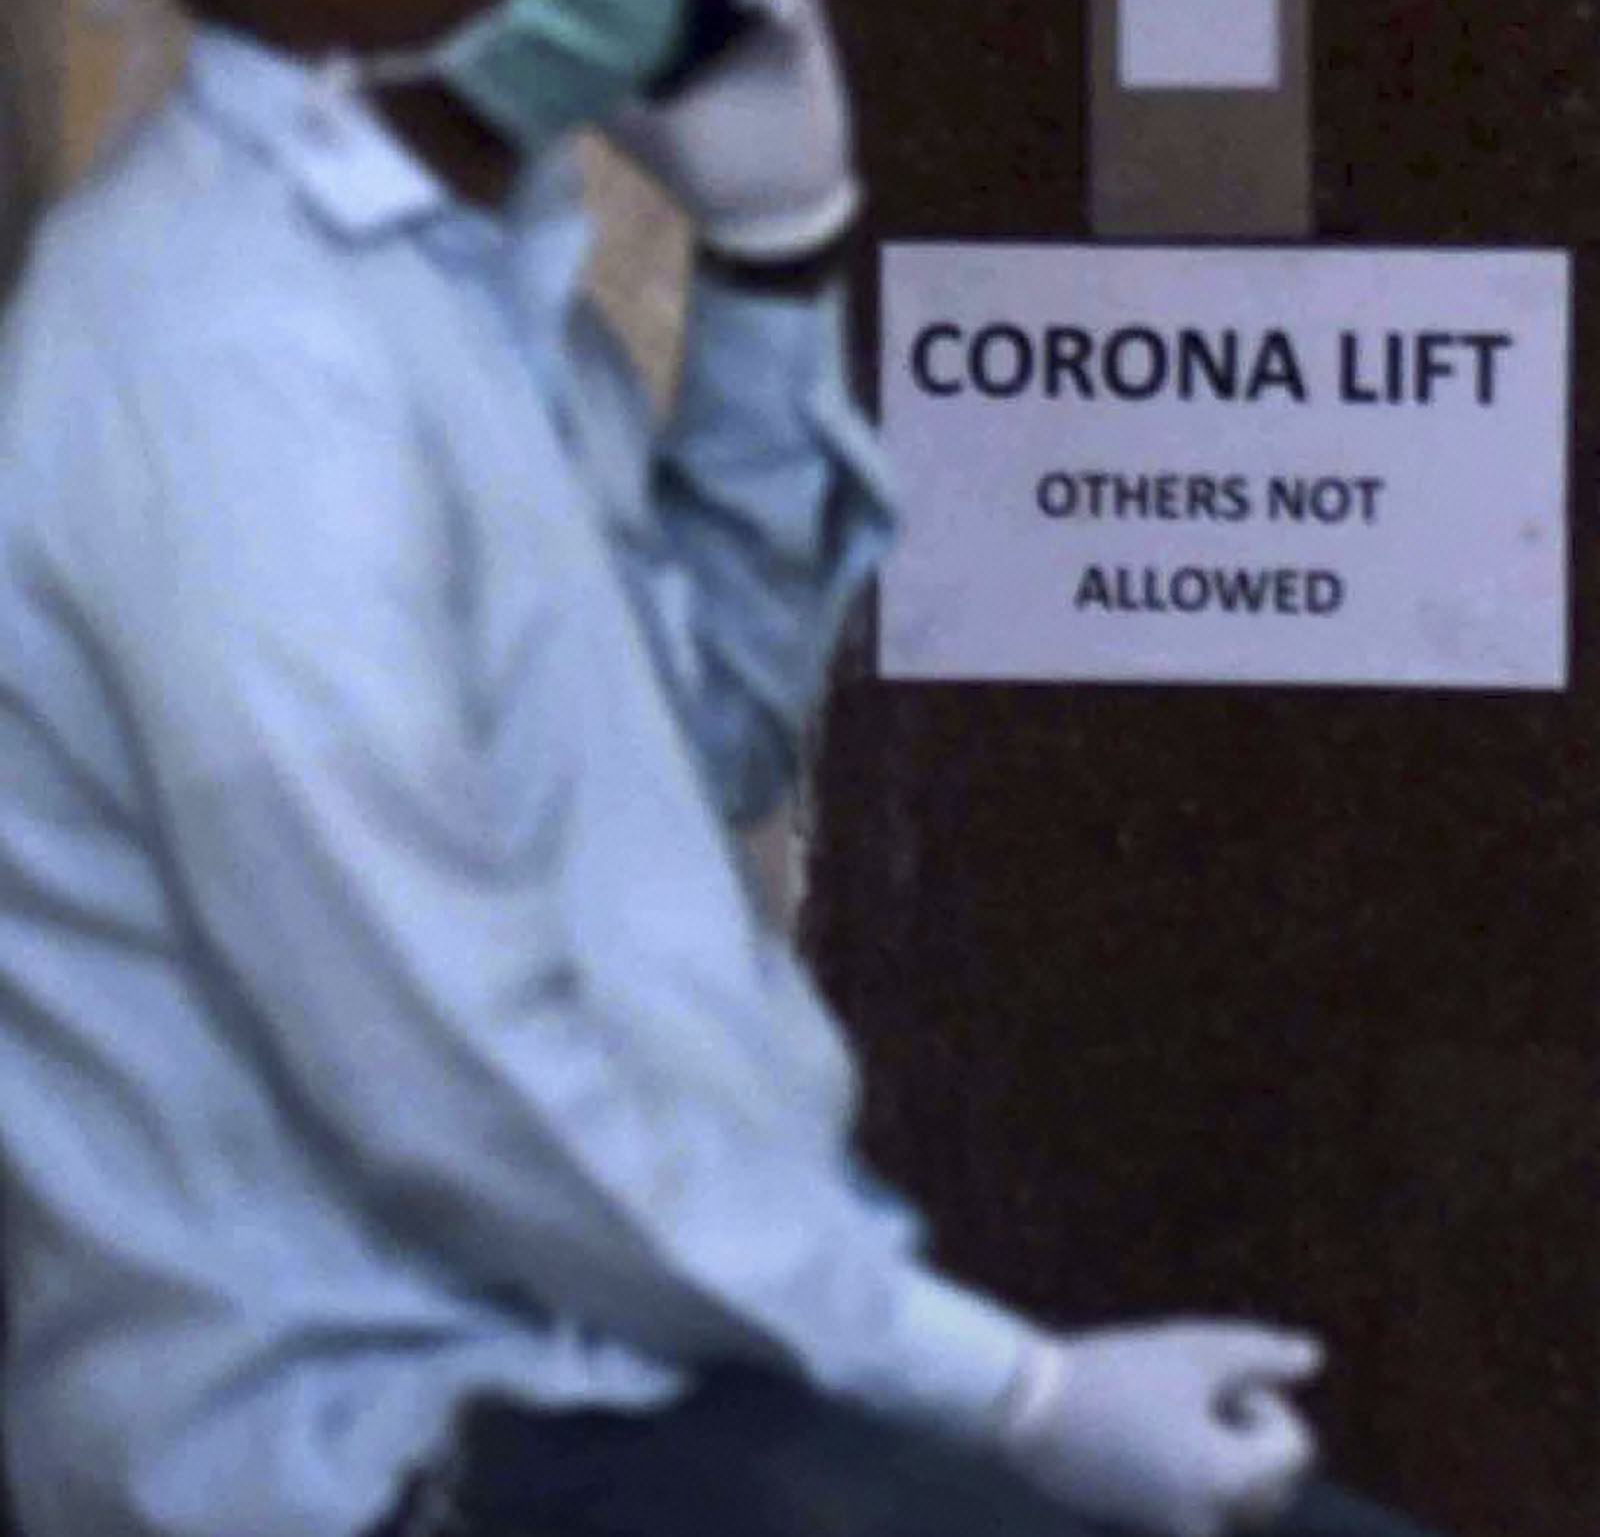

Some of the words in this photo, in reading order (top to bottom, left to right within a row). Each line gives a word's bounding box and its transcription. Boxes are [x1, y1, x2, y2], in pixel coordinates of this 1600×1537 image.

[909, 319, 1309, 404] CORONA
[1336, 328, 1515, 406] LIFT
[1034, 468, 1253, 524] OTHERS
[1265, 474, 1386, 526] NOT
[1072, 563, 1346, 616] ALLOWED
